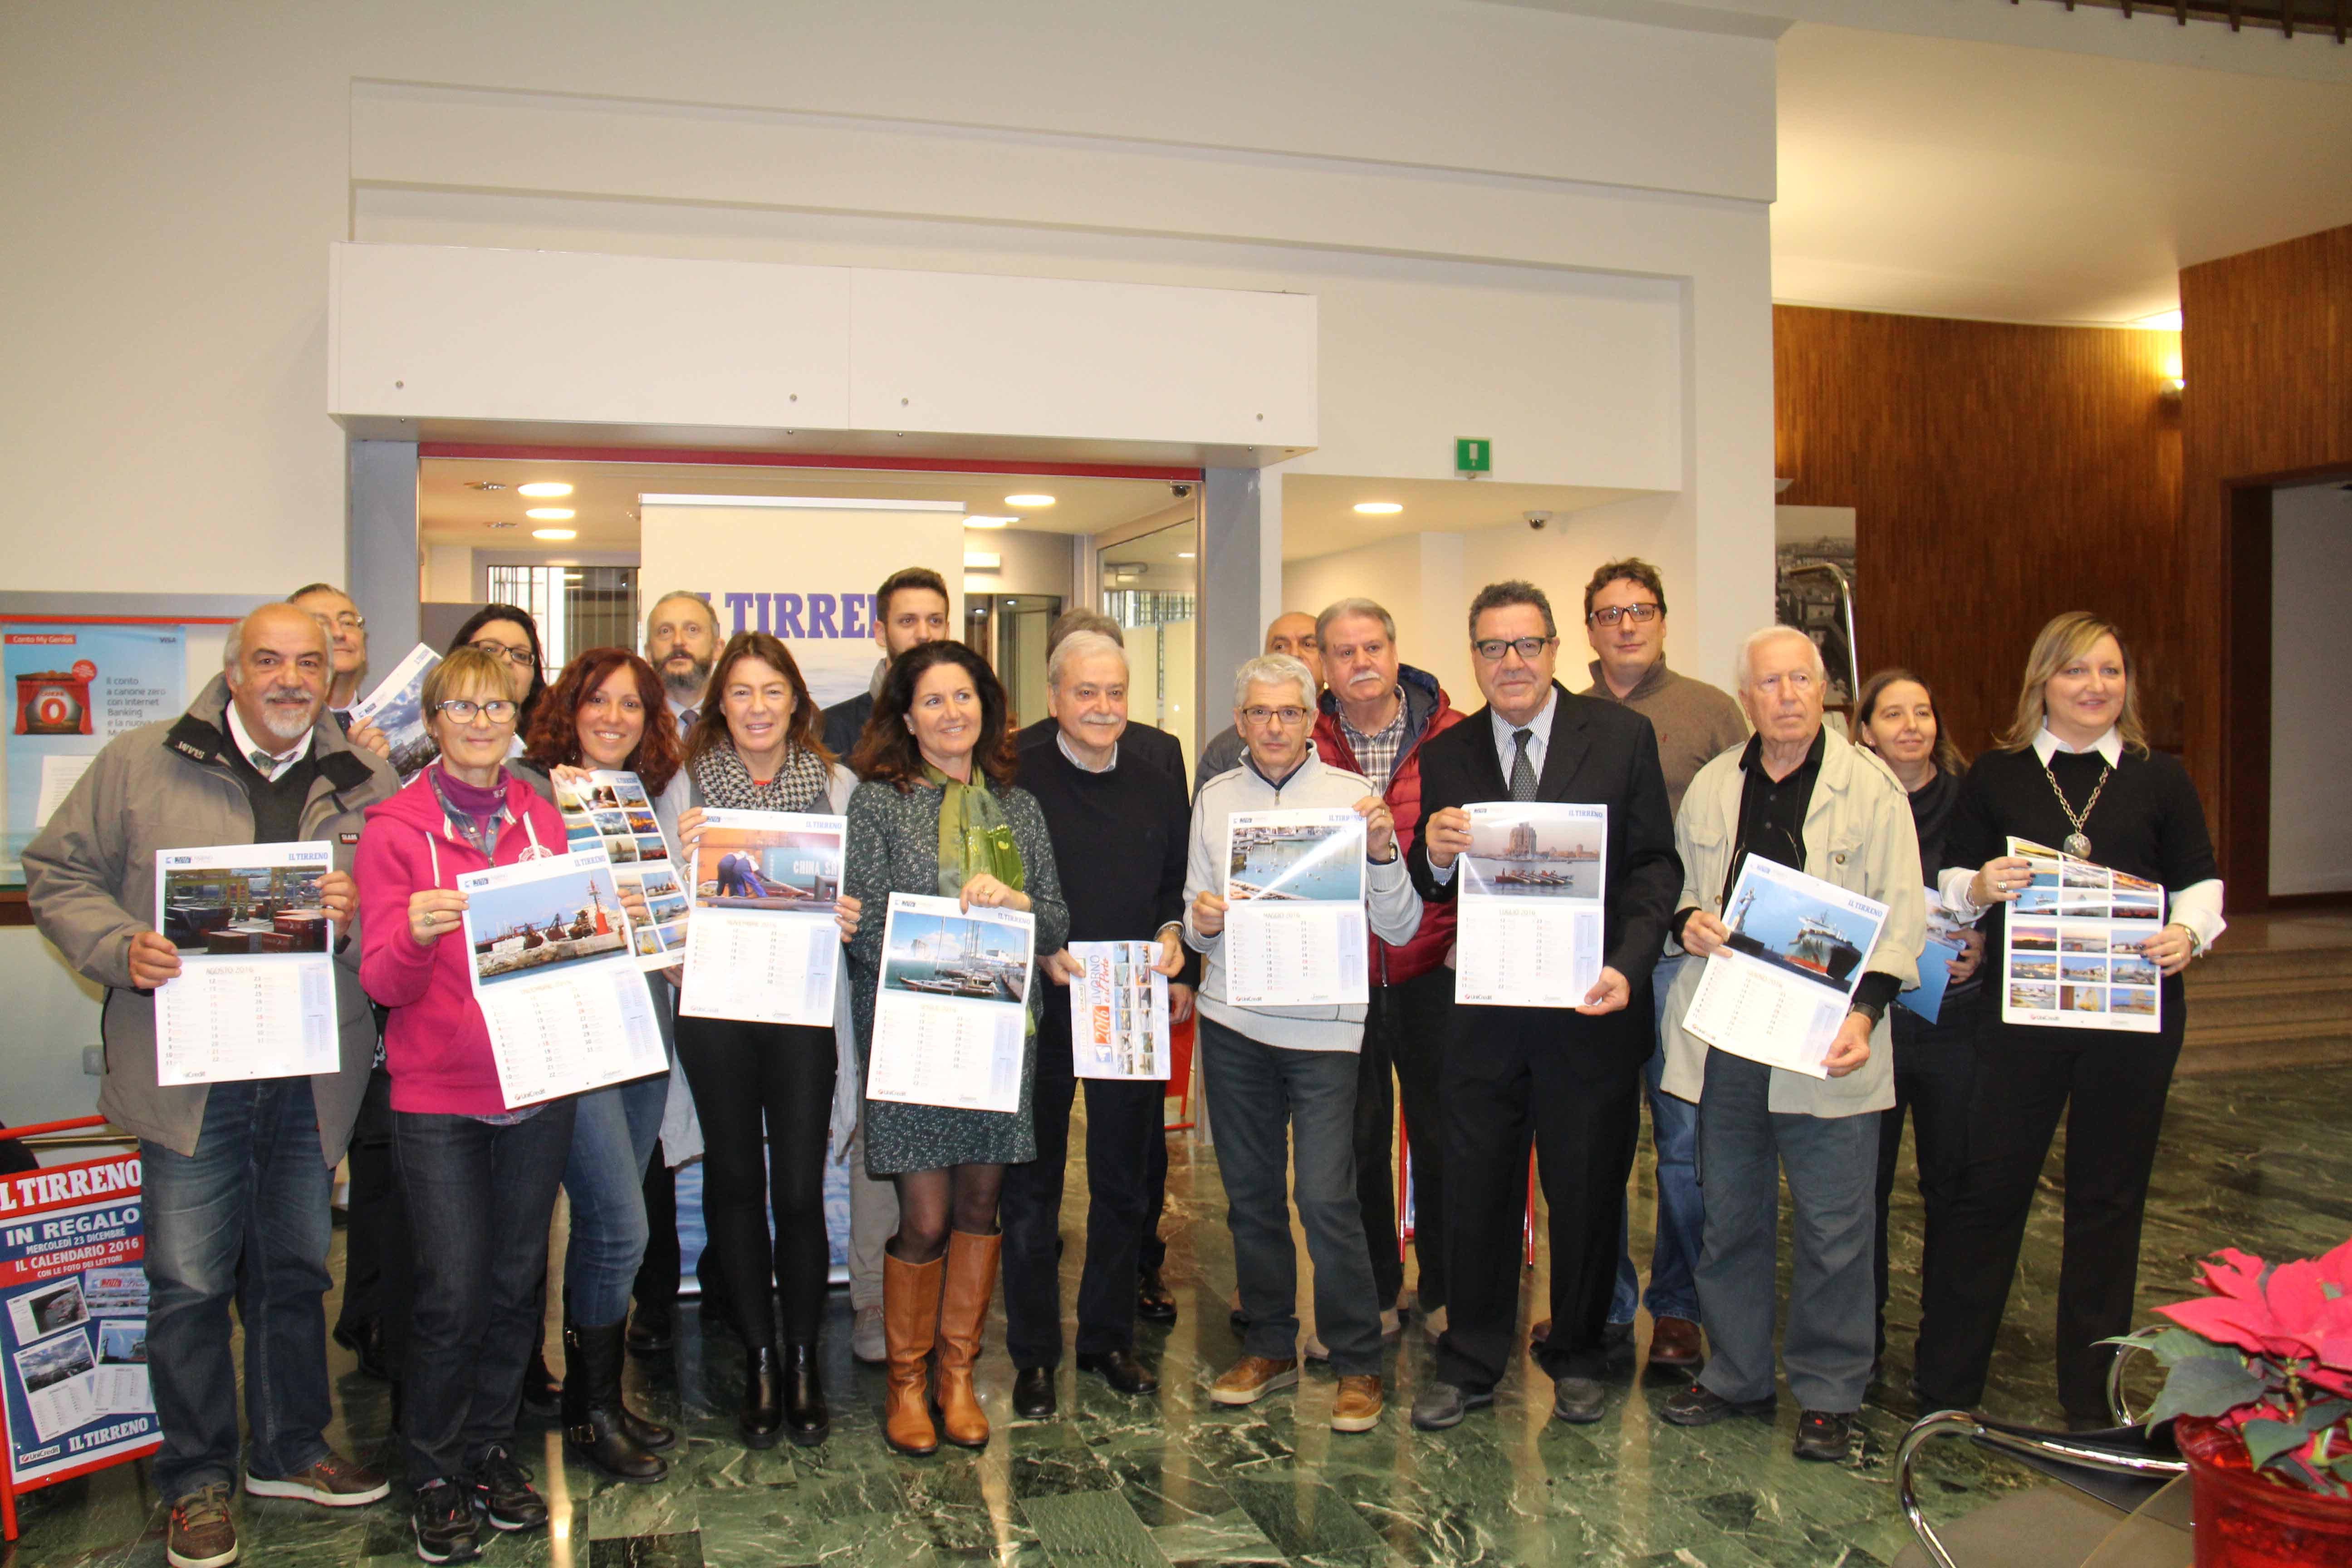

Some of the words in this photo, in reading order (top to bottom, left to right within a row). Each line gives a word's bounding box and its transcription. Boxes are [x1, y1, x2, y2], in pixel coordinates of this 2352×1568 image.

[725, 592, 878, 639] TIRRE
[108, 708, 142, 718] Banking
[794, 860, 820, 876] CHINA
[0, 1181, 17, 1211] L
[17, 1159, 142, 1207] TIRRENO
[6, 1226, 34, 1247] IN
[43, 1207, 140, 1240] REGALO
[74, 1236, 84, 1245] 23
[87, 1227, 126, 1241] DICEMBRE
[15, 1259, 28, 1273] IL
[30, 1244, 105, 1269] CALENDARIO
[109, 1238, 139, 1254] 2016
[37, 1269, 52, 1278] CON
[63, 1263, 81, 1273] FOTO
[95, 1254, 122, 1265] LETTORI
[29, 1446, 59, 1460] UniCredit
[69, 1436, 84, 1452] IL
[83, 1417, 149, 1447] TIRRENO
